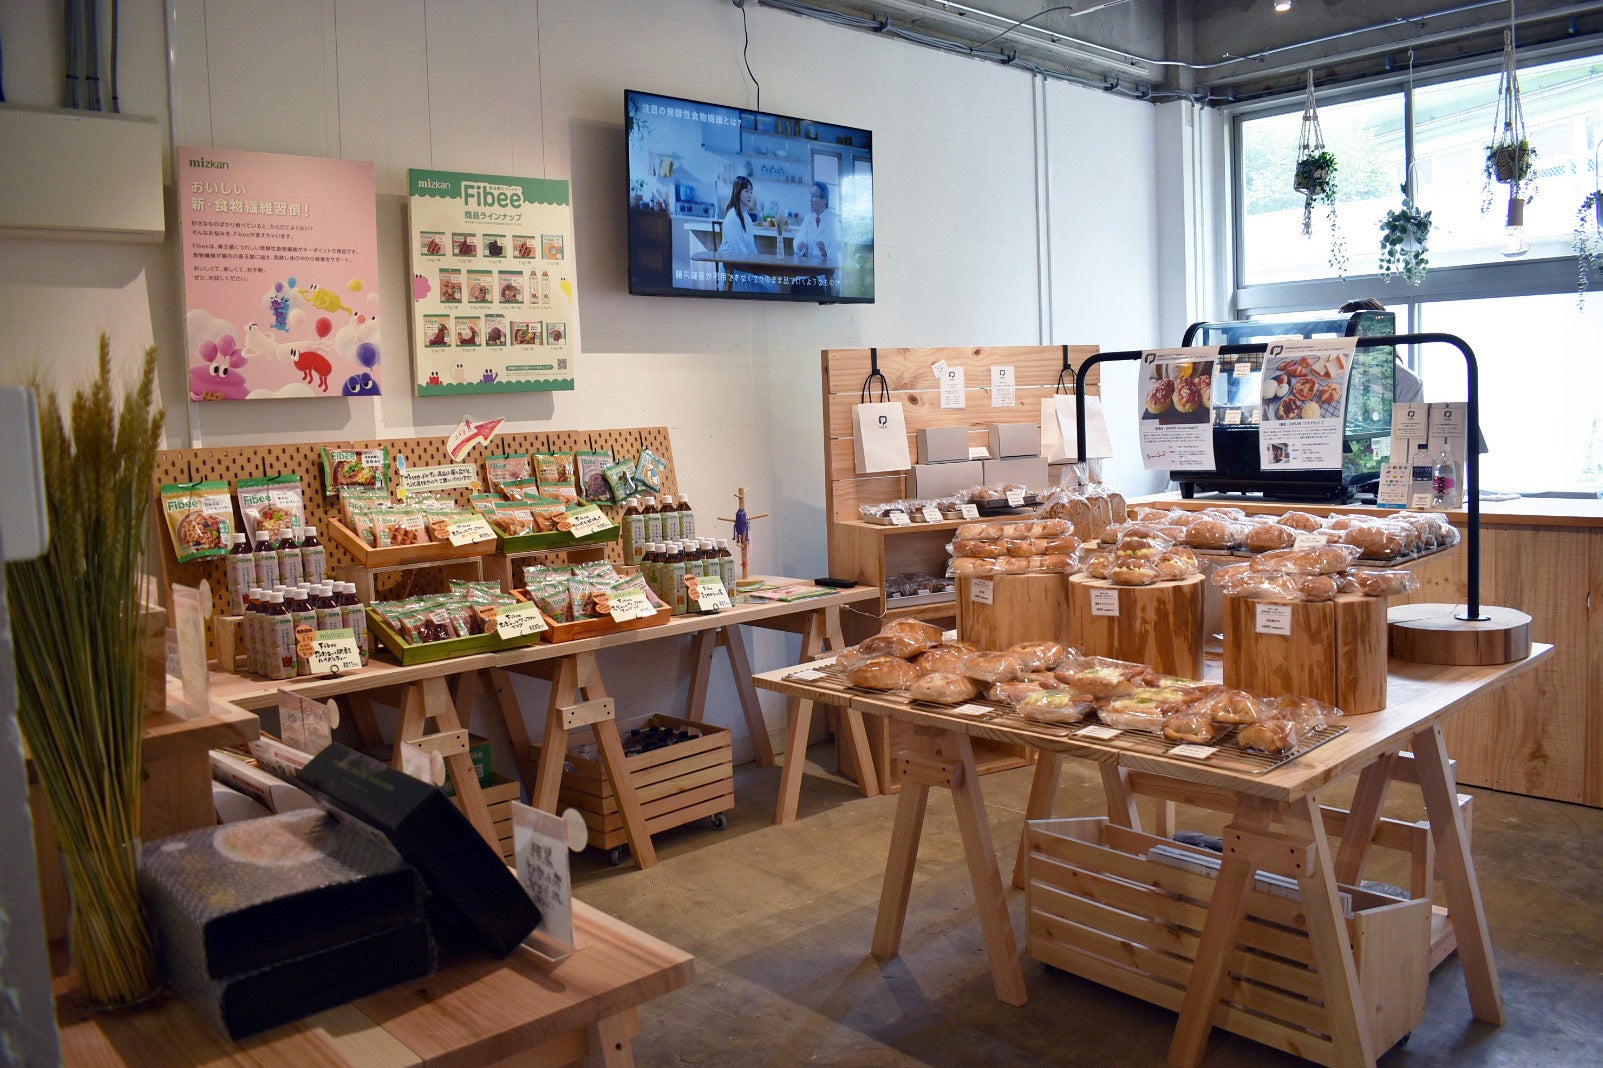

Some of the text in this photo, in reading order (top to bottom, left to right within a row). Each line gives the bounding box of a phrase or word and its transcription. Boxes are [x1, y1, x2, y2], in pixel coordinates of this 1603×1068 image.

[189, 157, 229, 170] mizkan
[191, 181, 247, 195] おいしい
[418, 179, 451, 189] mizkan
[464, 185, 522, 208] Fibee
[464, 211, 522, 222] 商品ラインナップ
[331, 452, 356, 461] Fibee
[167, 499, 199, 512] Fibee
[243, 494, 272, 505] Fibee
